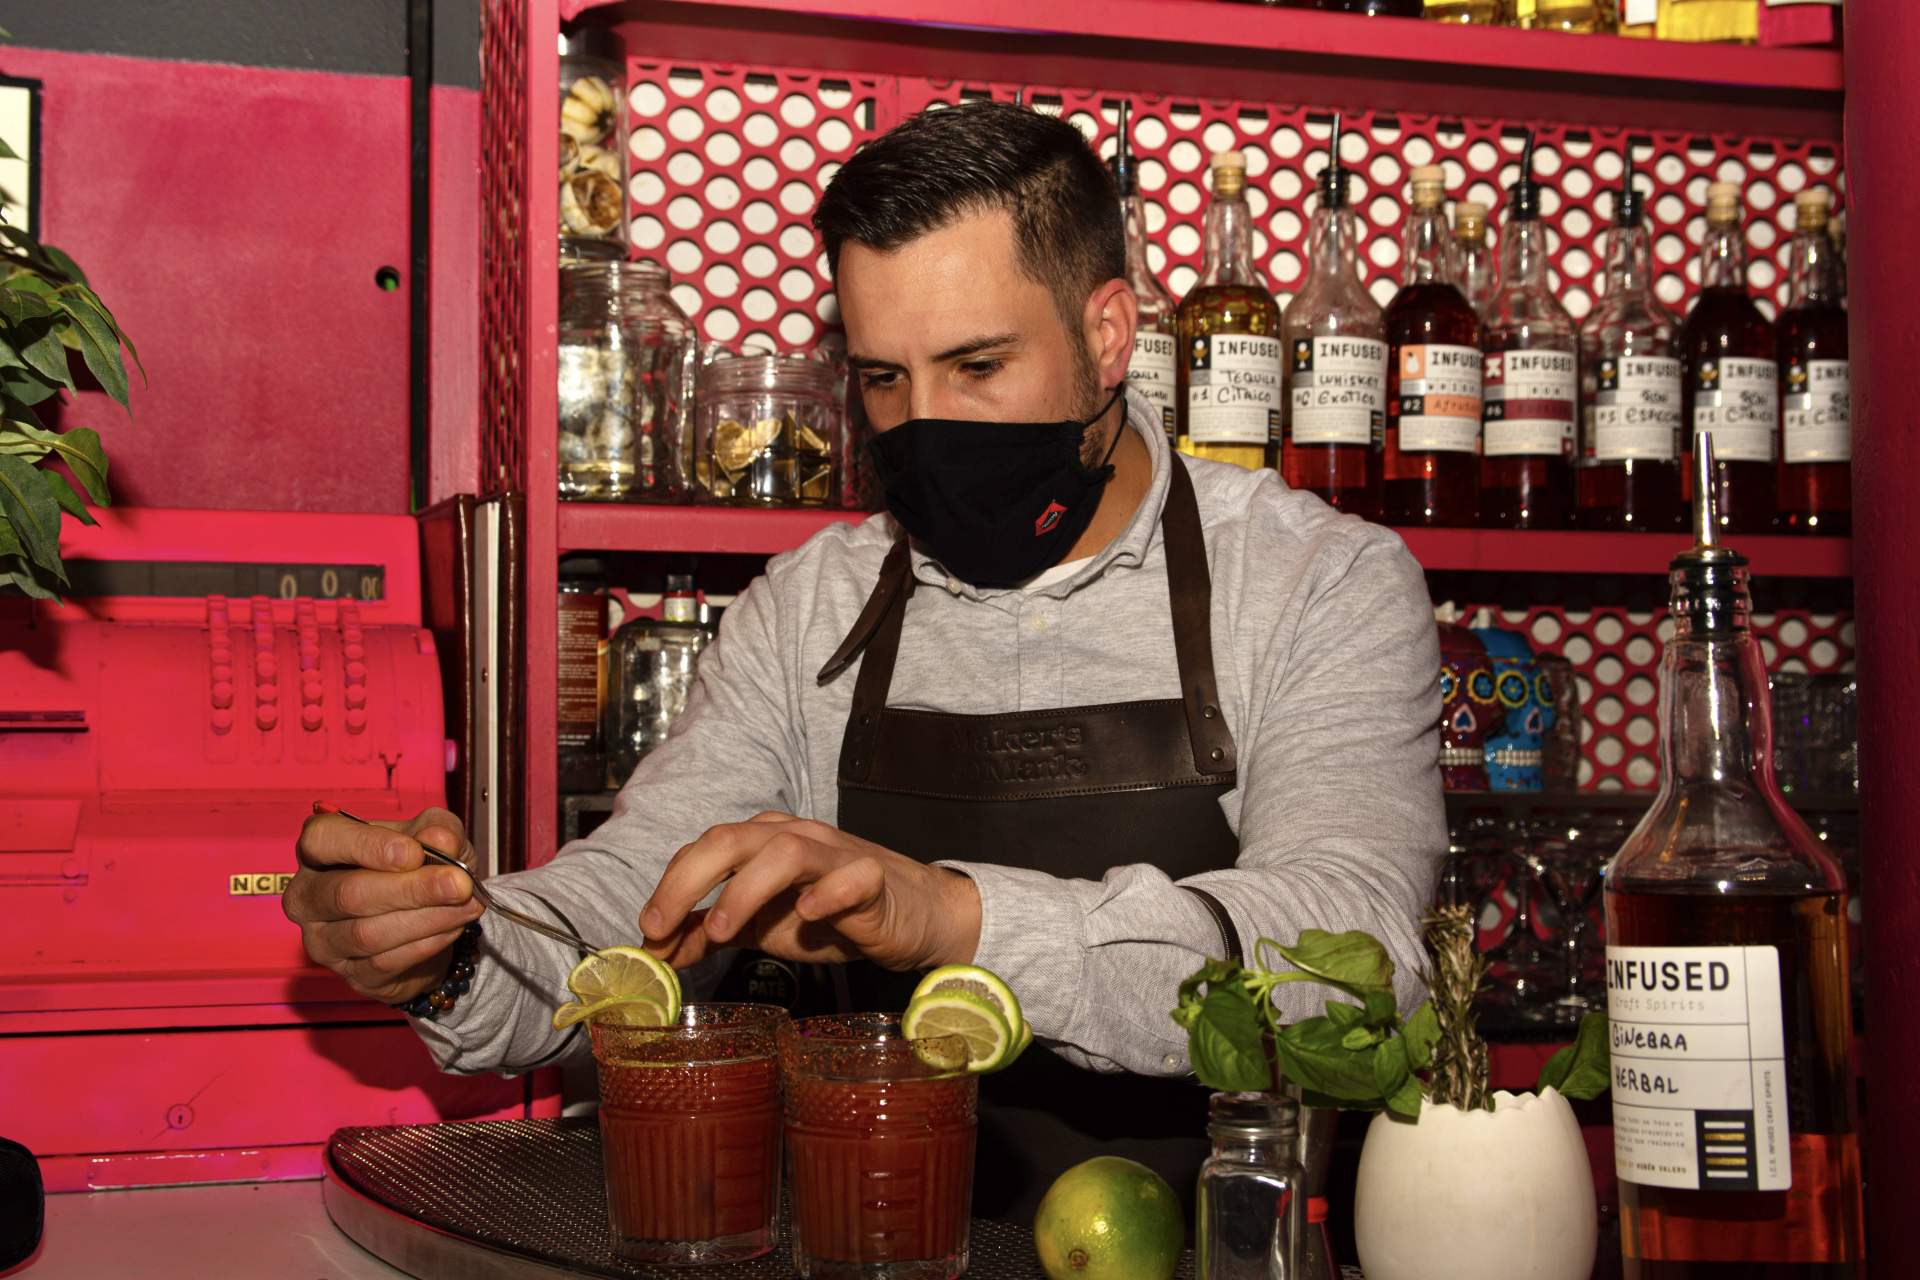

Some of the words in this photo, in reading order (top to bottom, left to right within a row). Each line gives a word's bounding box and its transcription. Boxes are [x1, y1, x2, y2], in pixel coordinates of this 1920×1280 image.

[1135, 339, 1174, 356] FUSED
[1218, 341, 1279, 360] INFUSED
[1320, 343, 1382, 360] INFUSED
[1432, 352, 1480, 369] INFUSE
[1511, 357, 1573, 371] INFUSED
[1219, 370, 1277, 385] TEQUILA
[1626, 363, 1680, 378] INFUSE
[1608, 959, 1729, 991] INFUSED
[1646, 998, 1705, 1012] Spirits
